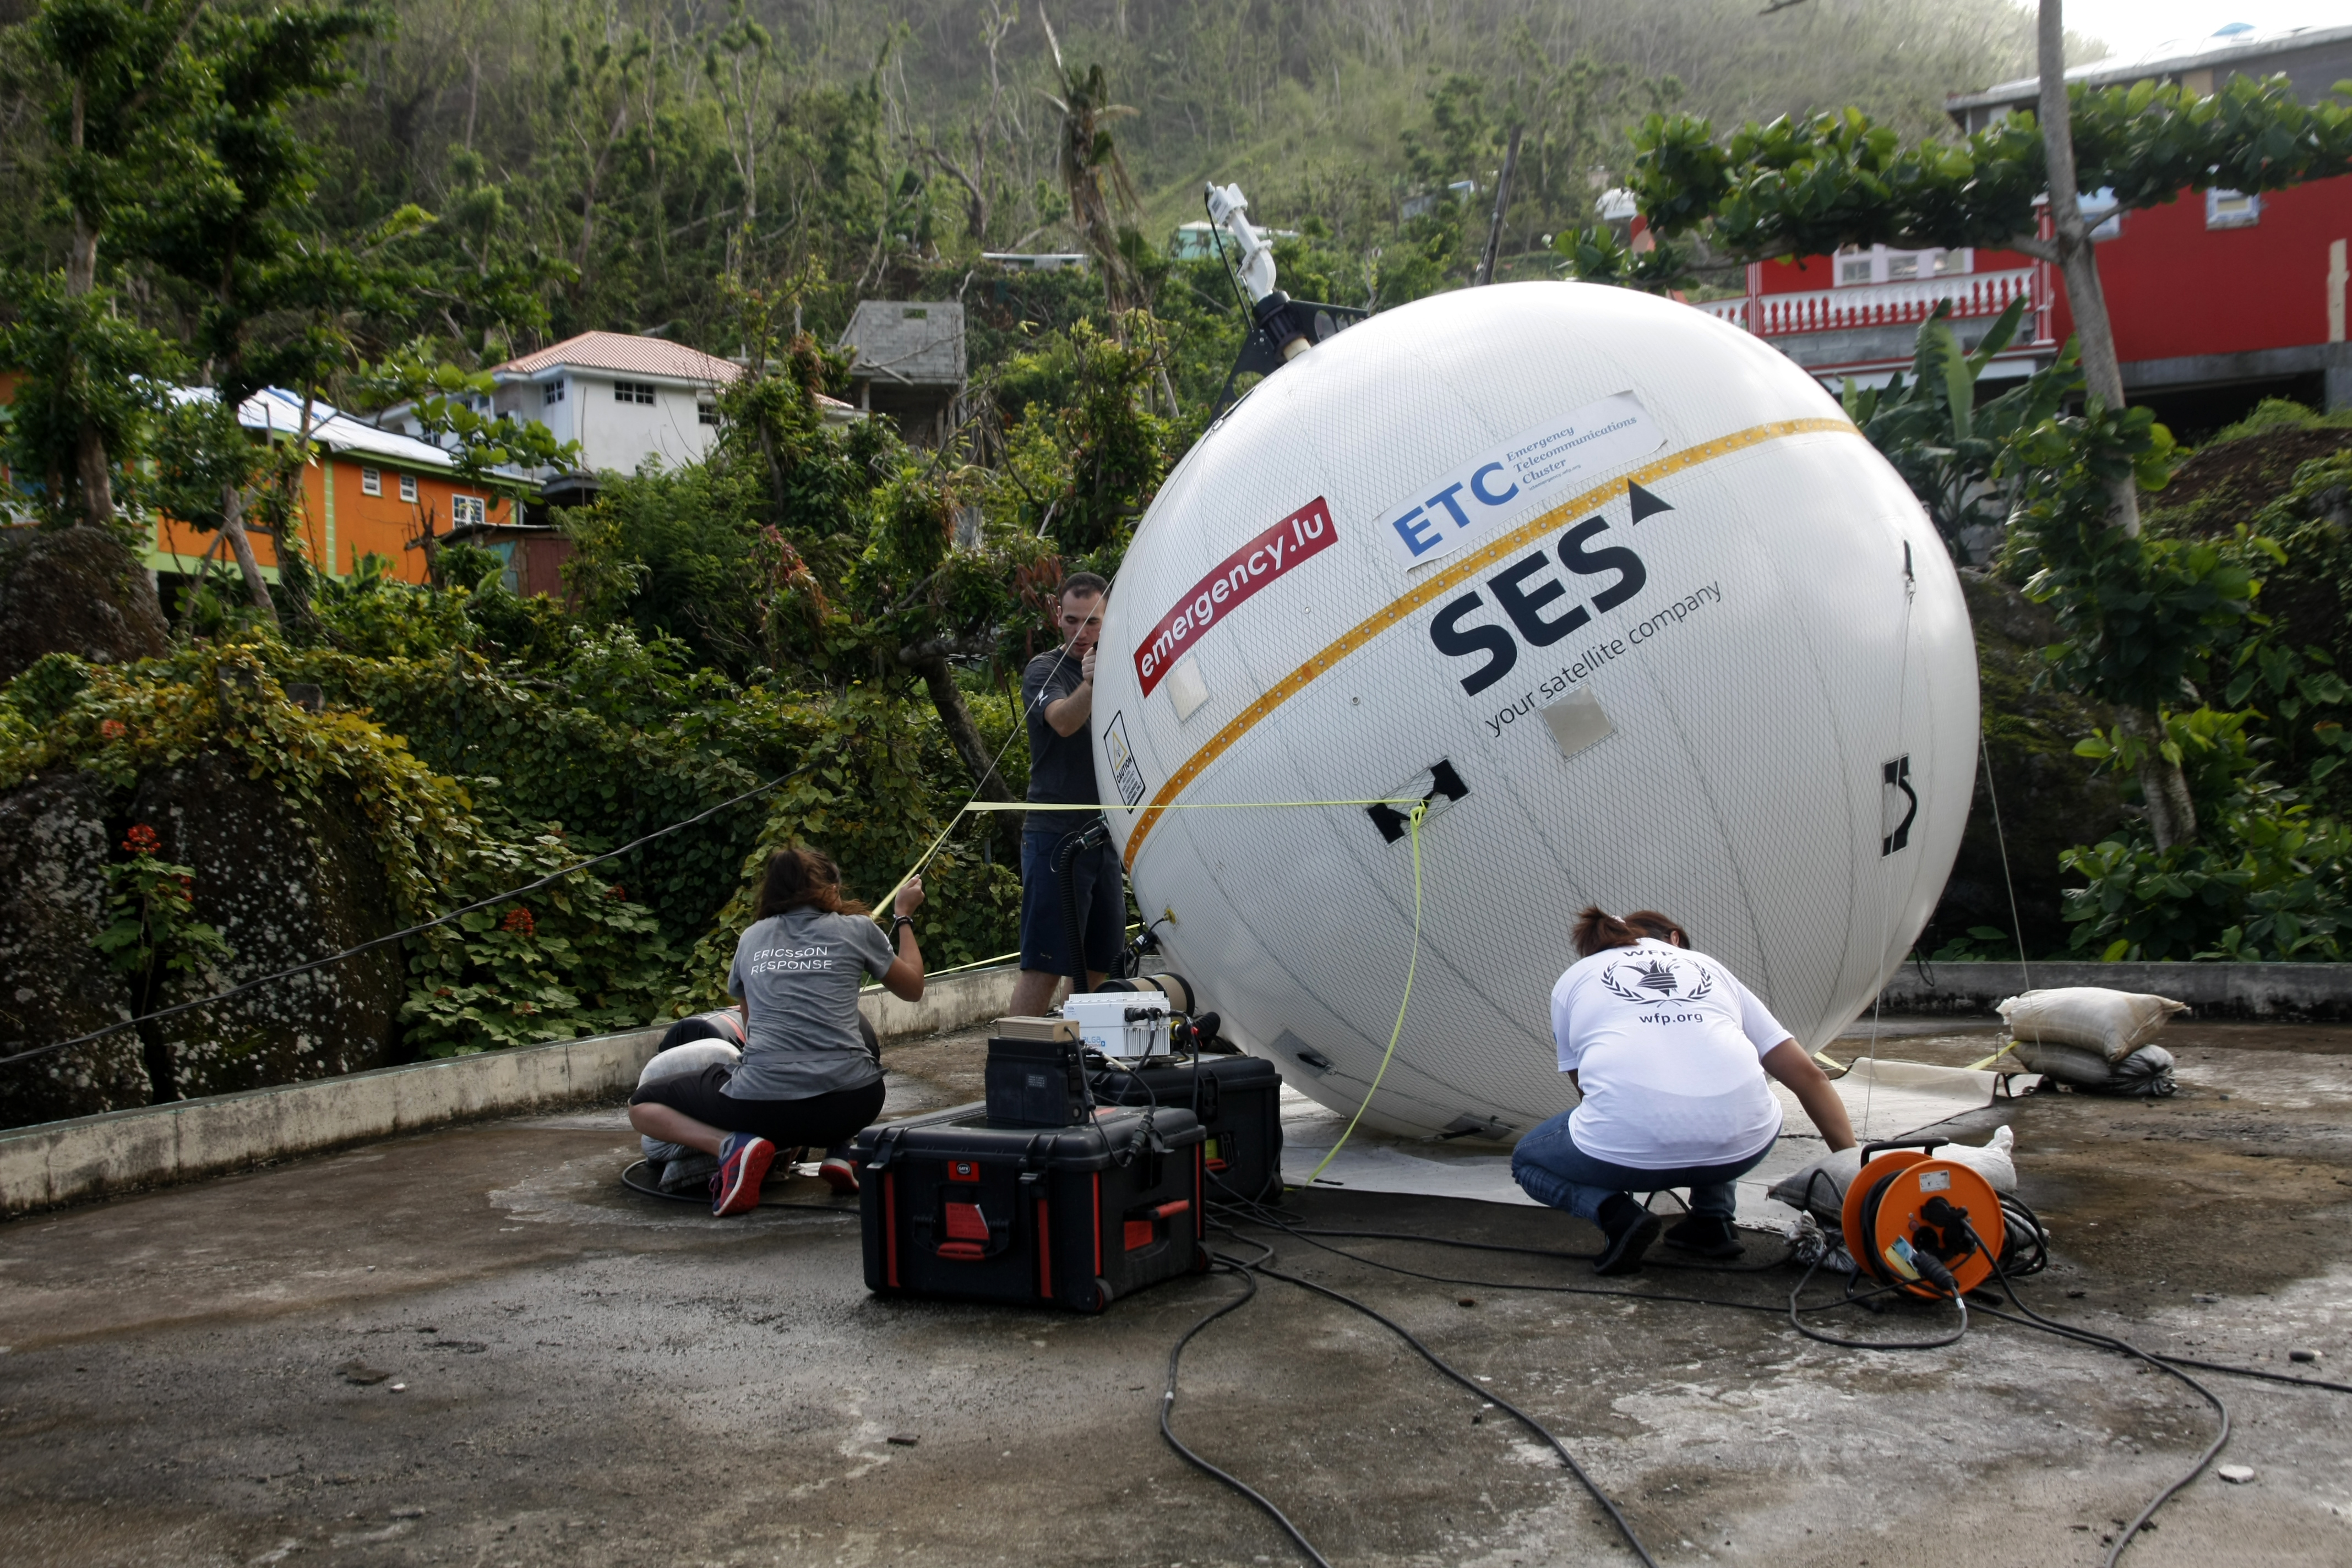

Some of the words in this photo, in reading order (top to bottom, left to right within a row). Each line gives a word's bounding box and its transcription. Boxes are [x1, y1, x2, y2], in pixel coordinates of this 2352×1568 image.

[1506, 427, 1575, 462] Emergency
[1513, 417, 1637, 473] Telecommunications
[1522, 459, 1567, 484] Cluster
[1392, 461, 1521, 558] ETC
[1141, 513, 1324, 678] emergency.lu
[1429, 514, 1647, 698] SES
[1485, 690, 1536, 738] your
[1539, 639, 1627, 699] satellite
[1628, 580, 1722, 644] company
[1117, 755, 1133, 783] CAUTION
[750, 959, 832, 976] RESPONSE
[753, 946, 828, 962] ERICSSON
[1638, 1012, 1703, 1026] wfp.org
